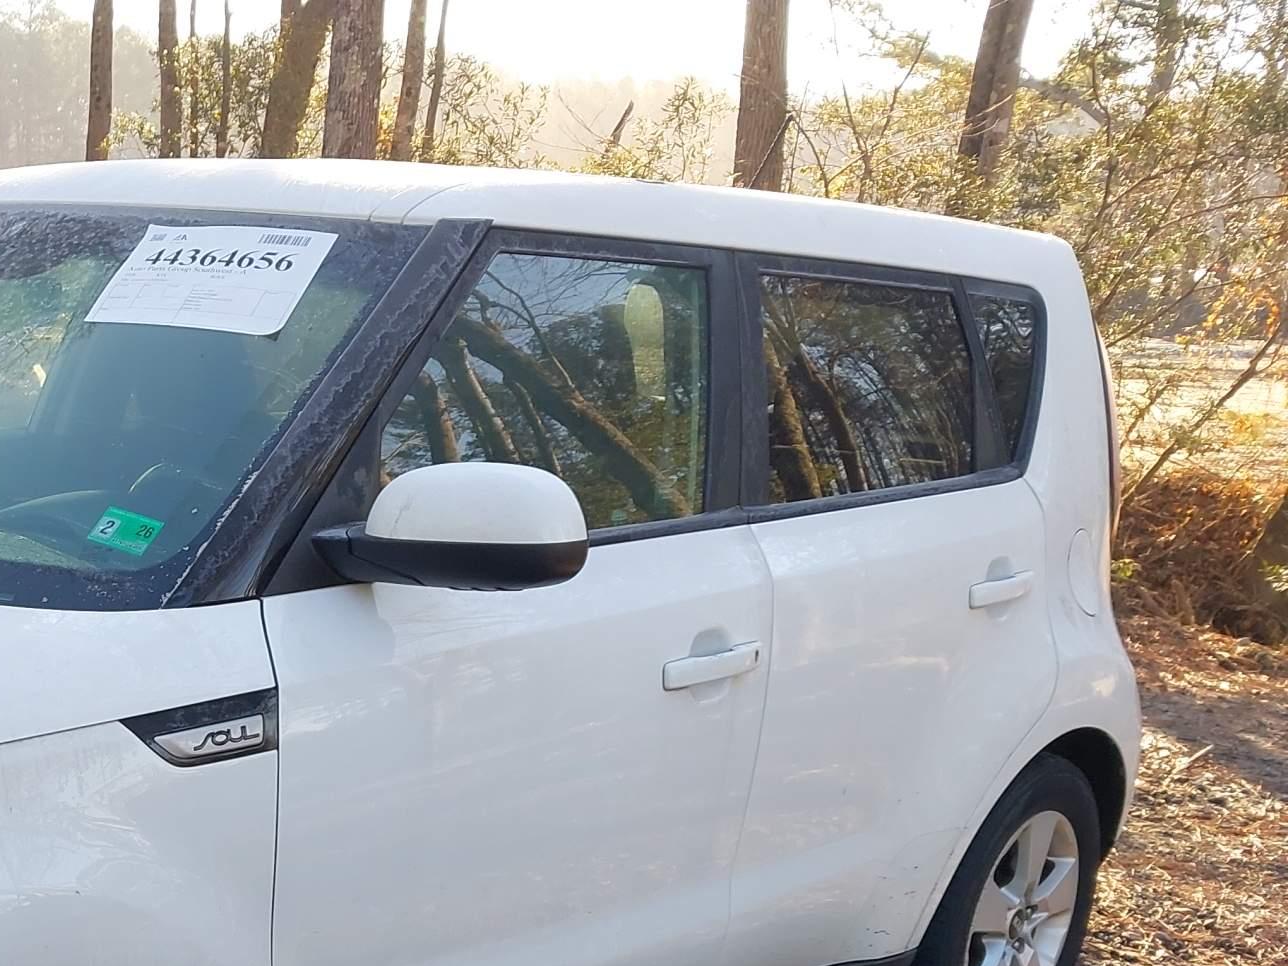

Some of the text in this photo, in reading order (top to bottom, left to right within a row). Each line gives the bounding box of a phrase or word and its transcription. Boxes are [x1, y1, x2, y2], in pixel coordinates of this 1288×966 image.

[145, 248, 300, 272] 44364656
[100, 520, 154, 539] 2 26
[193, 725, 260, 751] SOUL
